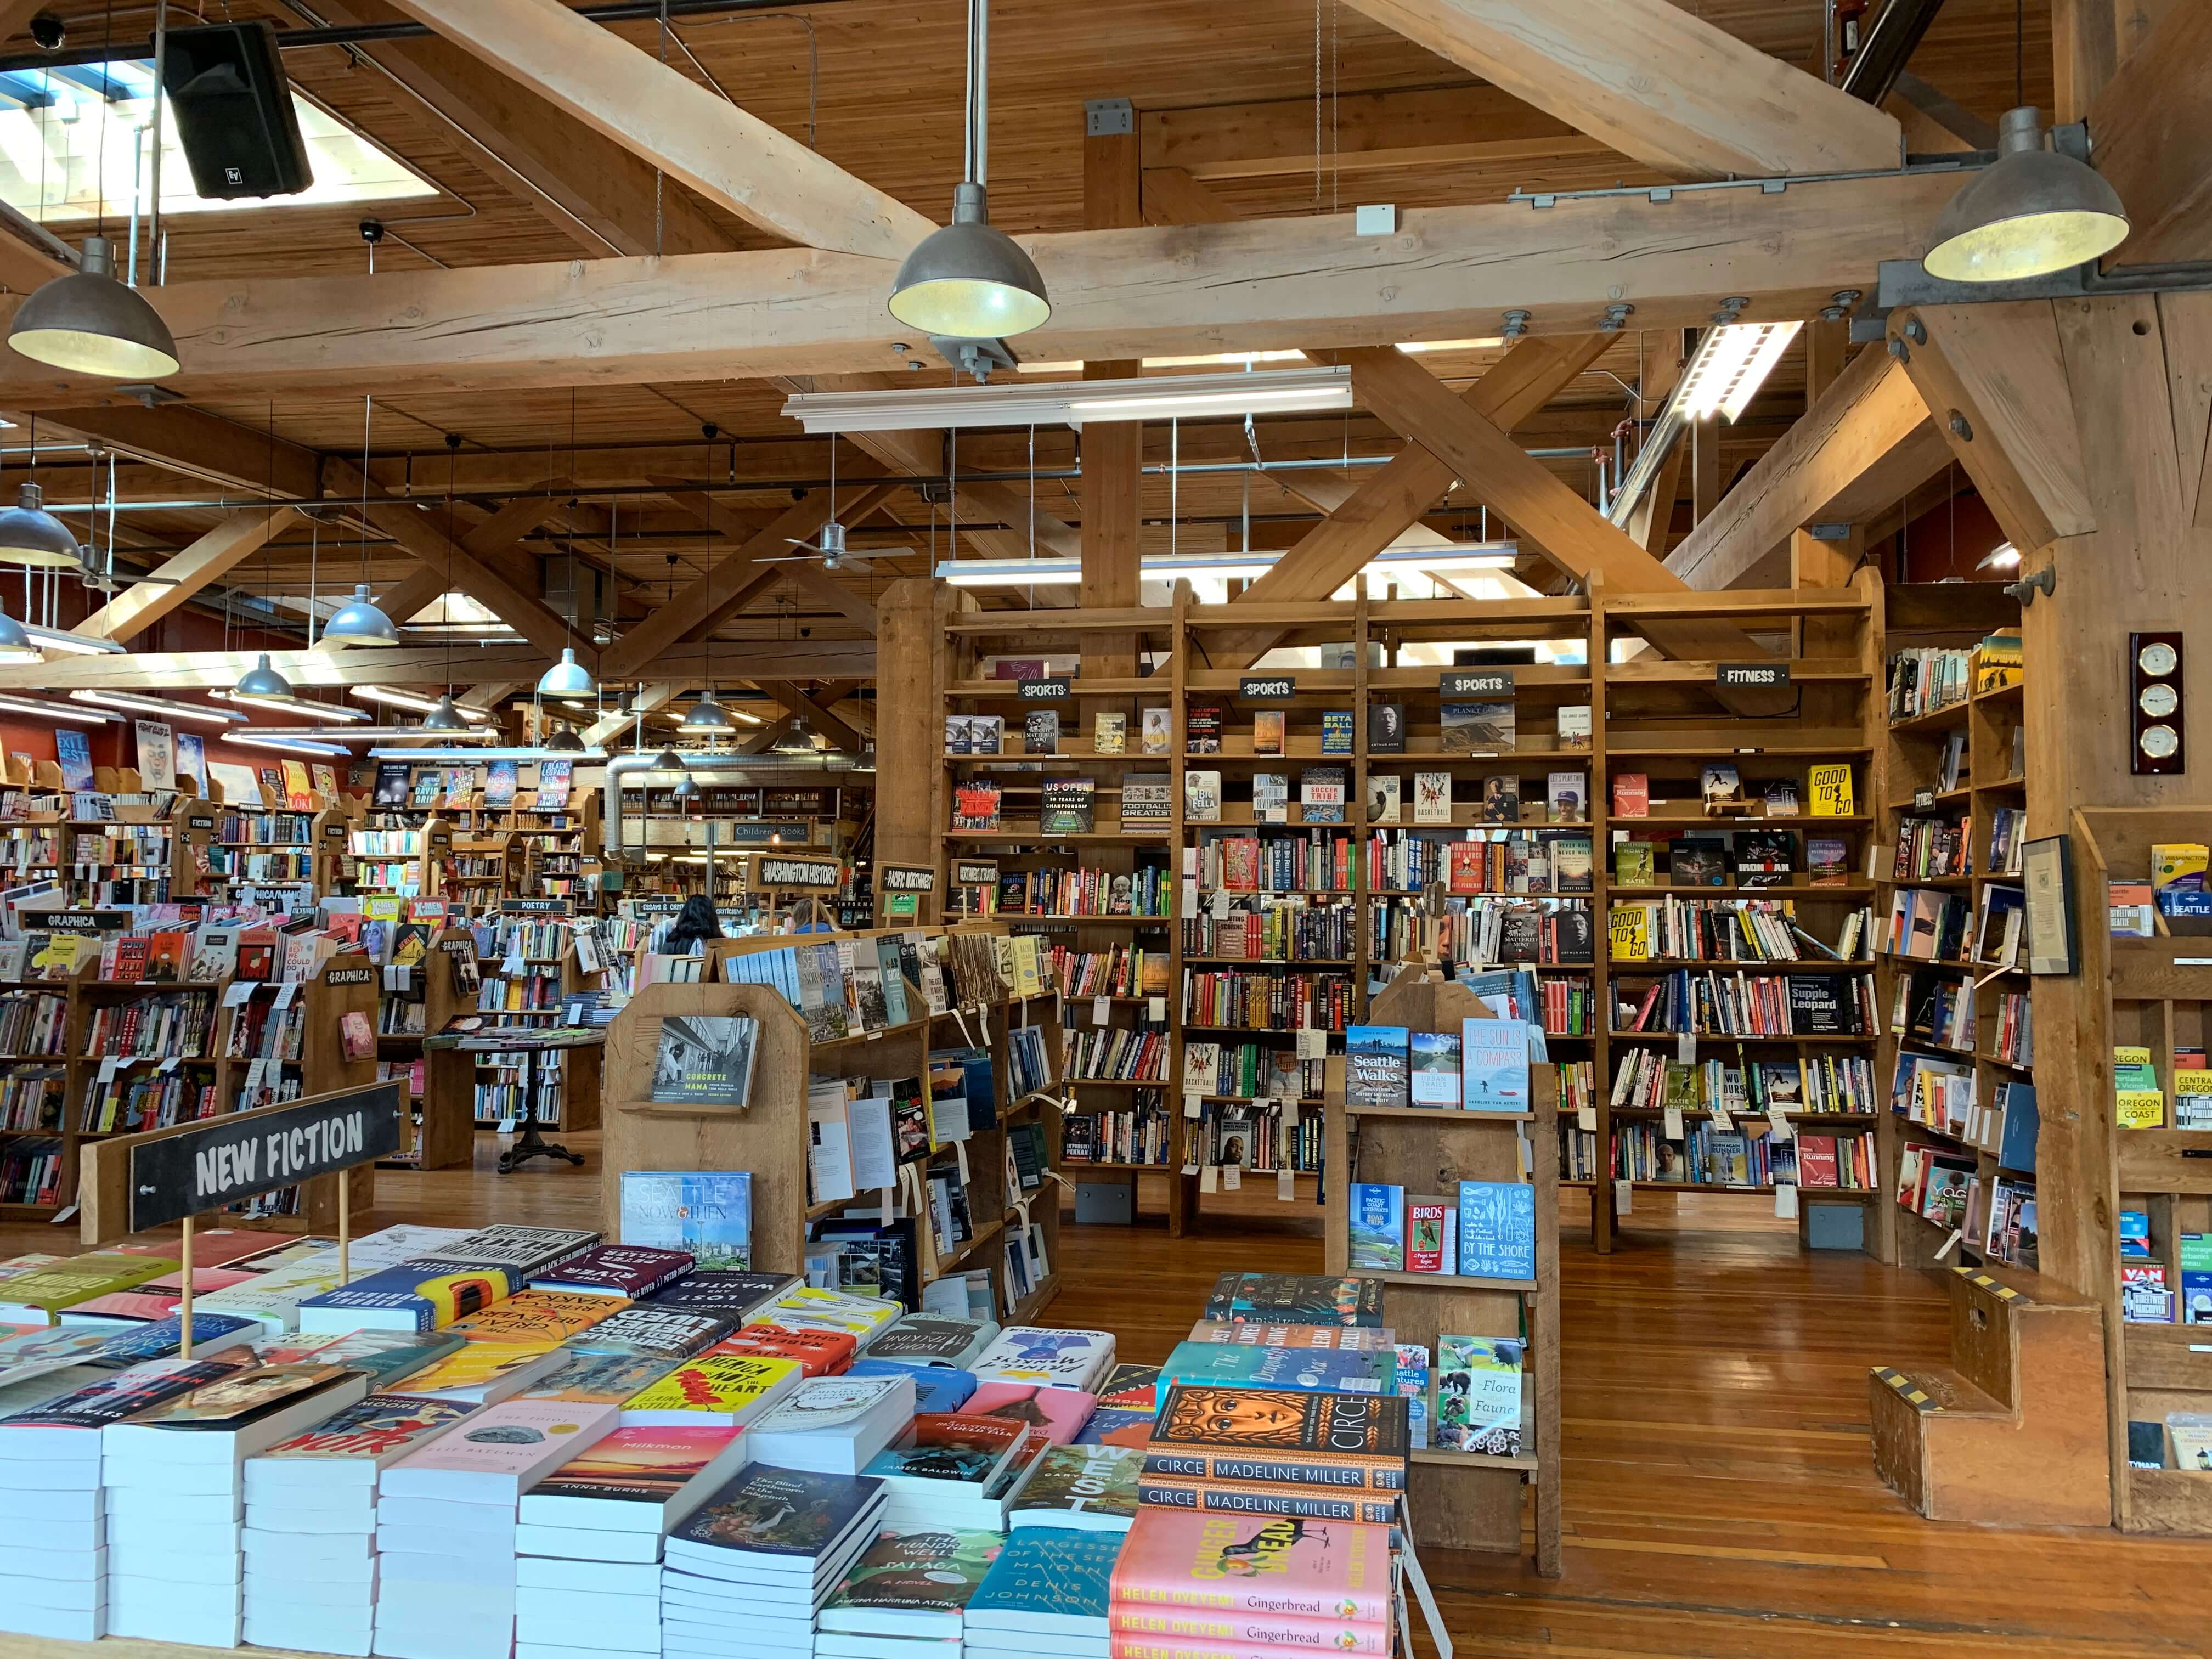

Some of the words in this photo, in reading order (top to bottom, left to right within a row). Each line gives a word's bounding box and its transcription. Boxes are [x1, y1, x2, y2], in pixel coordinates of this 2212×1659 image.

[1727, 669, 1775, 683] FITNESS
[1025, 684, 1064, 697] SPORTS
[1246, 682, 1289, 696] SPORTS
[1455, 678, 1503, 691] SPORTS
[58, 735, 83, 751] EXIT
[1815, 769, 1846, 786] GOOD
[1062, 782, 1090, 791] OPEN
[1819, 787, 1832, 800] TO
[289, 798, 312, 810] LOKI
[1193, 800, 1215, 808] FELLA
[1835, 799, 1851, 814] GO
[1916, 793, 1932, 808] FITNESS
[1418, 809, 1448, 817] BASKETBALL
[781, 827, 805, 835] Books
[764, 861, 809, 883] WASHINGTON
[809, 864, 837, 885] HISTORY
[960, 866, 979, 881] NORTHWEST
[979, 867, 995, 881] LITERATURE
[887, 870, 905, 888] PACIFIC
[905, 872, 932, 890] NORTHWEST
[521, 901, 551, 910] POETRY
[48, 916, 96, 927] GRAPHICA
[1612, 911, 1641, 927] GOOD
[1616, 928, 1628, 944] TO
[443, 940, 472, 951] GRAPHICA
[1630, 941, 1646, 956] GO
[330, 969, 369, 983] GRAPHICA
[1792, 989, 1829, 1000] Supple
[1792, 1000, 1836, 1011] Leopard
[1467, 1029, 1485, 1045] THE
[1489, 1029, 1509, 1045] SUN
[1513, 1029, 1521, 1045] IS
[1353, 1056, 1400, 1068] Seattle
[1467, 1051, 1472, 1065] A
[1476, 1051, 1522, 1066] COMPASS
[686, 1073, 727, 1082] CONCRETE
[1356, 1069, 1397, 1081] Walks
[196, 1137, 258, 1197] NEW
[267, 1111, 363, 1177] FICTION
[1803, 1153, 1835, 1162] Running
[639, 1184, 725, 1205] SEATTLE
[639, 1206, 673, 1220] NOW
[676, 1205, 688, 1220] &
[687, 1206, 727, 1220] THEN
[1413, 1206, 1442, 1219] BIRDS
[1464, 1243, 1476, 1254] BY
[1477, 1243, 1495, 1255] THE
[1498, 1244, 1530, 1258] SHORE
[561, 1267, 639, 1281] RIVER
[630, 1289, 639, 1299] THE
[640, 1281, 655, 1297] RIVER
[663, 1271, 677, 1284] PETER
[677, 1261, 693, 1279] HELLER
[2125, 1269, 2162, 1282] VAN
[680, 1280, 774, 1291] WANTED
[677, 1293, 738, 1302] LOST
[511, 1300, 593, 1313] REBECCA
[476, 1319, 549, 1330] GREAT
[615, 1309, 719, 1329] LIVED
[596, 1318, 699, 1338] NEVER
[574, 1331, 680, 1351] FAMOUS
[880, 1334, 947, 1343] TALKING
[878, 1342, 939, 1351] WOMEN
[696, 1354, 773, 1375] AMERICA
[711, 1384, 773, 1397] HEART
[1483, 1380, 1516, 1394] Flora
[356, 1400, 419, 1411] MOORE
[1475, 1400, 1515, 1415] Fauna
[1330, 1396, 1367, 1450] CIRCE
[622, 1442, 692, 1451] Milkman
[881, 1464, 918, 1473] JAMES
[921, 1468, 973, 1476] BALDWIN
[1156, 1459, 1204, 1474] CIRCE
[1216, 1462, 1300, 1481] MADELINE
[1305, 1469, 1362, 1485] MILLER
[560, 1482, 600, 1492] ANNA
[603, 1485, 650, 1494] BURNS
[774, 1480, 803, 1489] Blind
[741, 1489, 791, 1502] Labyrinth
[1148, 1490, 1195, 1506] CIRCE
[1207, 1494, 1289, 1513] MADELINE
[1296, 1502, 1350, 1517] MILLER
[895, 1541, 978, 1551] HUNDRED
[1017, 1540, 1119, 1552] LARGESSE
[1190, 1519, 1239, 1580] GINGER
[904, 1549, 958, 1557] WELLS
[880, 1561, 961, 1571] SALAGA
[1013, 1562, 1101, 1575] MAIDEN
[1015, 1579, 1081, 1592] DENIS
[985, 1591, 1097, 1606] JOHNSON
[1122, 1587, 1167, 1602] HELEN
[1172, 1590, 1235, 1607] OYEYEMI
[1247, 1595, 1321, 1615] Gingerbread
[1121, 1616, 1167, 1631] HELEN
[1171, 1620, 1234, 1637] OYEYEMI
[1246, 1626, 1320, 1645] Gingerbread
